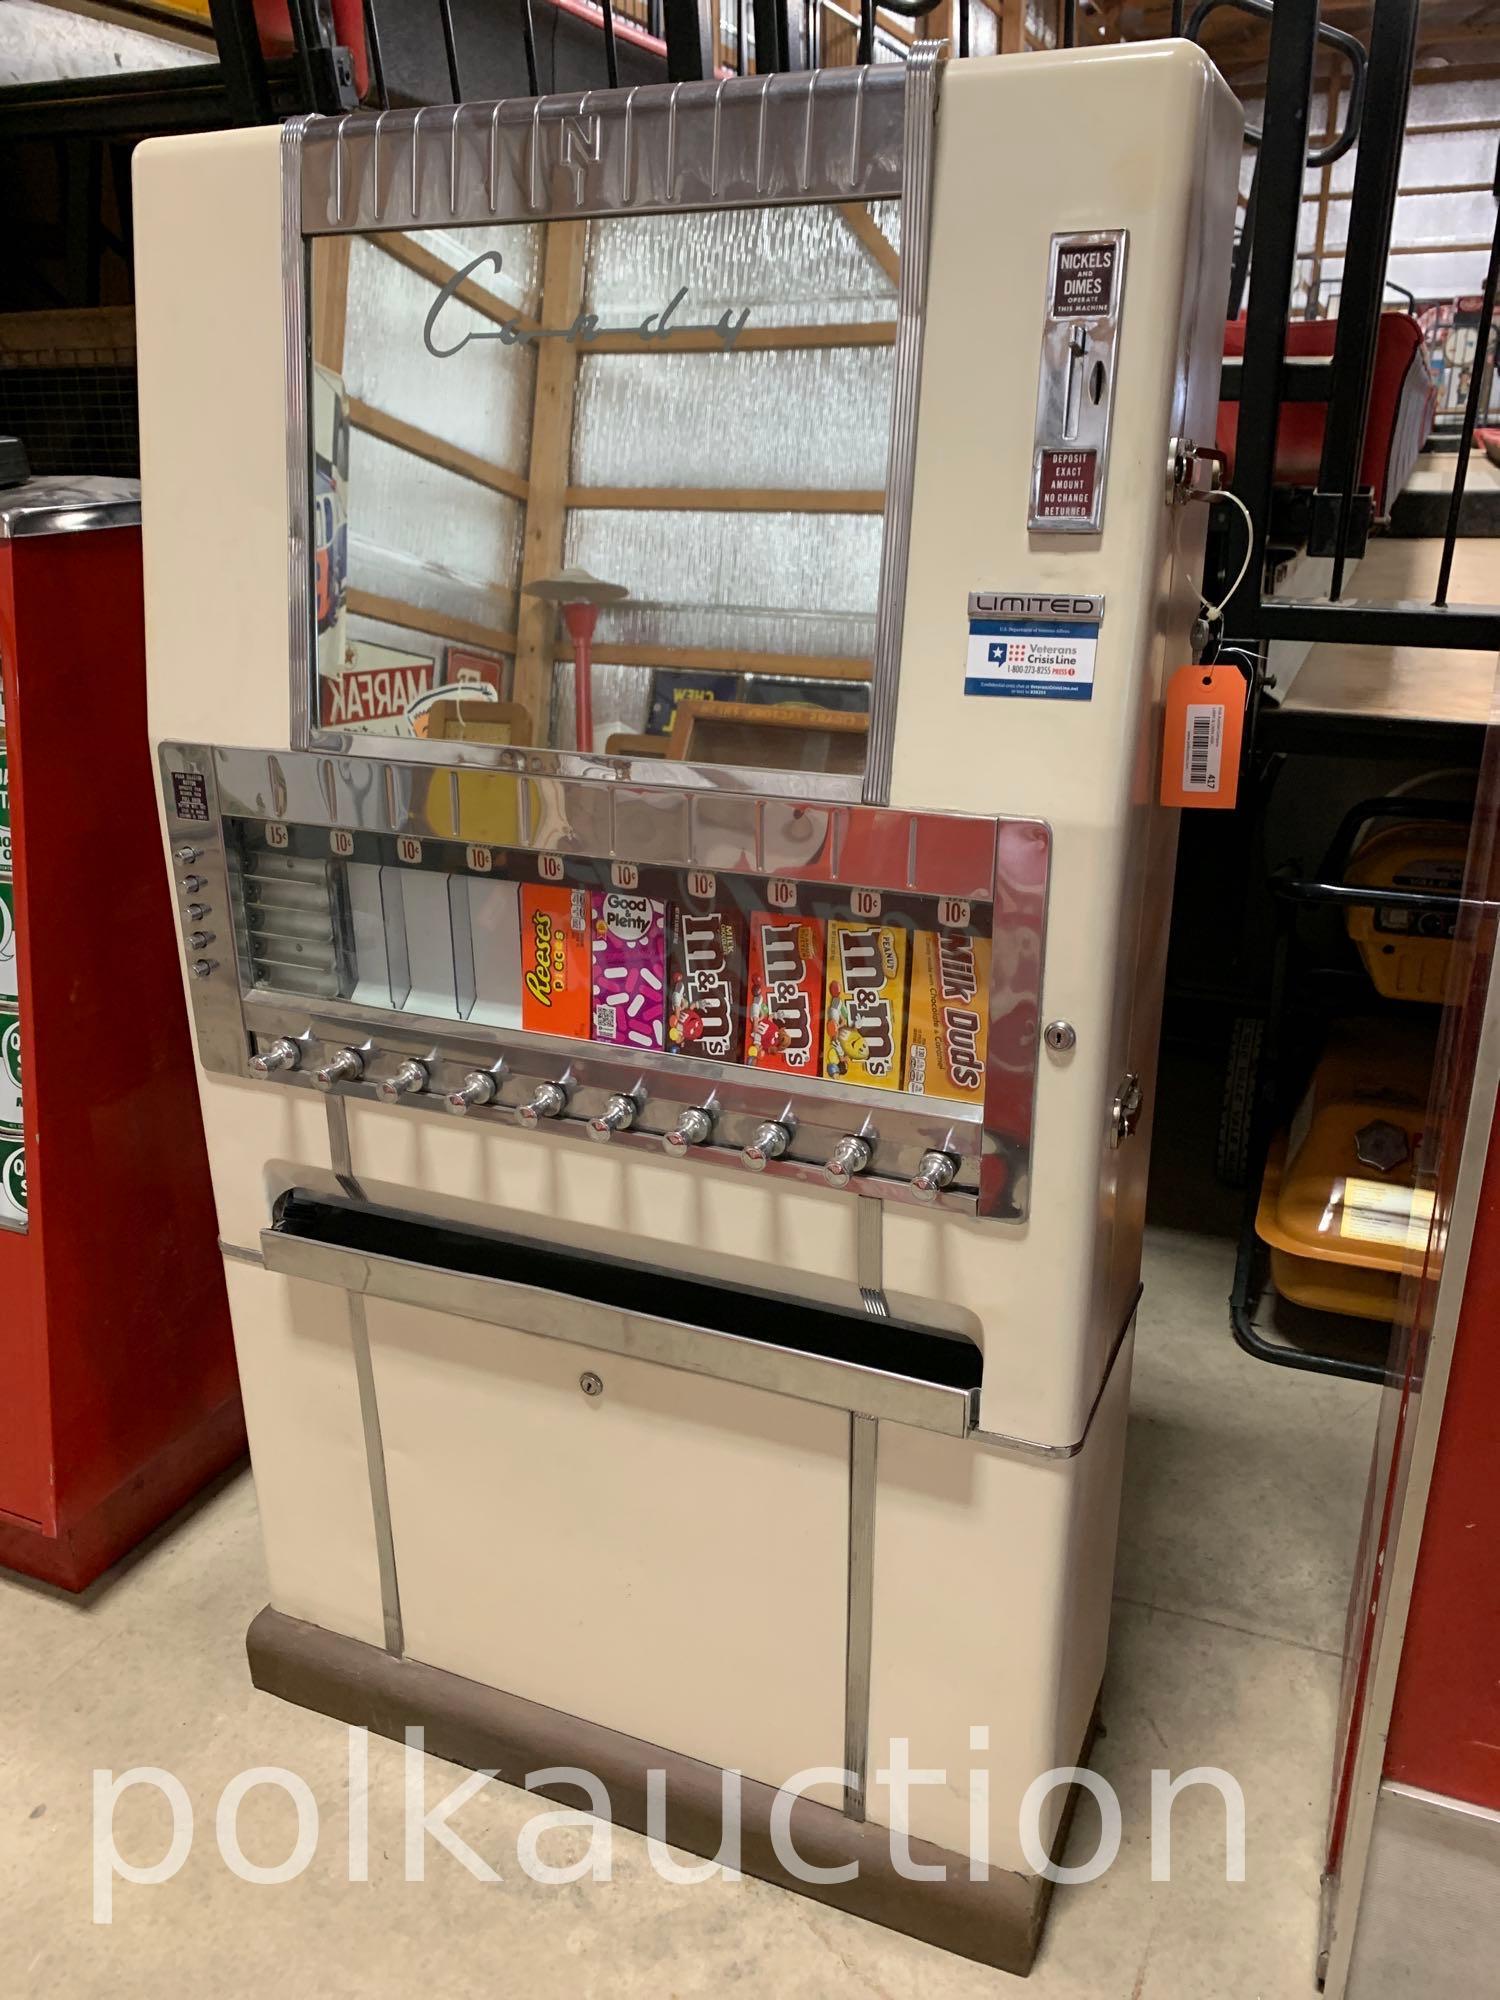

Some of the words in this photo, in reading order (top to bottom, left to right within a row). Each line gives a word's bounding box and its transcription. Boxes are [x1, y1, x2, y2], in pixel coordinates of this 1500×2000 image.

[1061, 252, 1112, 269] NICKELS
[1064, 278, 1102, 295] DIMES
[423, 250, 751, 358] Candy
[1052, 454, 1087, 464] DEPOSIT
[1056, 467, 1082, 476] EXACT
[1051, 480, 1084, 489] AMOUNT
[1044, 493, 1055, 503] NO
[1057, 493, 1089, 503] CHANGE
[1044, 506, 1086, 516] RETURNED
[977, 596, 1094, 614] LIMITED
[1030, 644, 1077, 655] Veterans
[1027, 654, 1055, 664] Crisis
[1055, 656, 1077, 665] Line
[1007, 665, 1051, 675] 1-800-273-8255
[1207, 774, 1215, 789] 417
[271, 826, 287, 844] 15¢
[335, 833, 351, 852] 10¢
[403, 841, 419, 859] 10¢
[472, 849, 489, 867] 10¢
[544, 857, 561, 876] 10¢
[617, 866, 636, 885] 10¢
[694, 874, 713, 894] 10¢
[775, 883, 794, 903] 10¢
[608, 895, 647, 912] Good
[857, 892, 878, 913] 10¢
[945, 902, 966, 923] 10¢
[607, 912, 650, 933] Plenty
[726, 925, 734, 953] MILK
[525, 908, 552, 1007] Reese's
[882, 936, 894, 970] PEANUT
[937, 932, 977, 1004] Milk
[929, 988, 940, 1028] Chocolate
[944, 1006, 984, 1089] Duds
